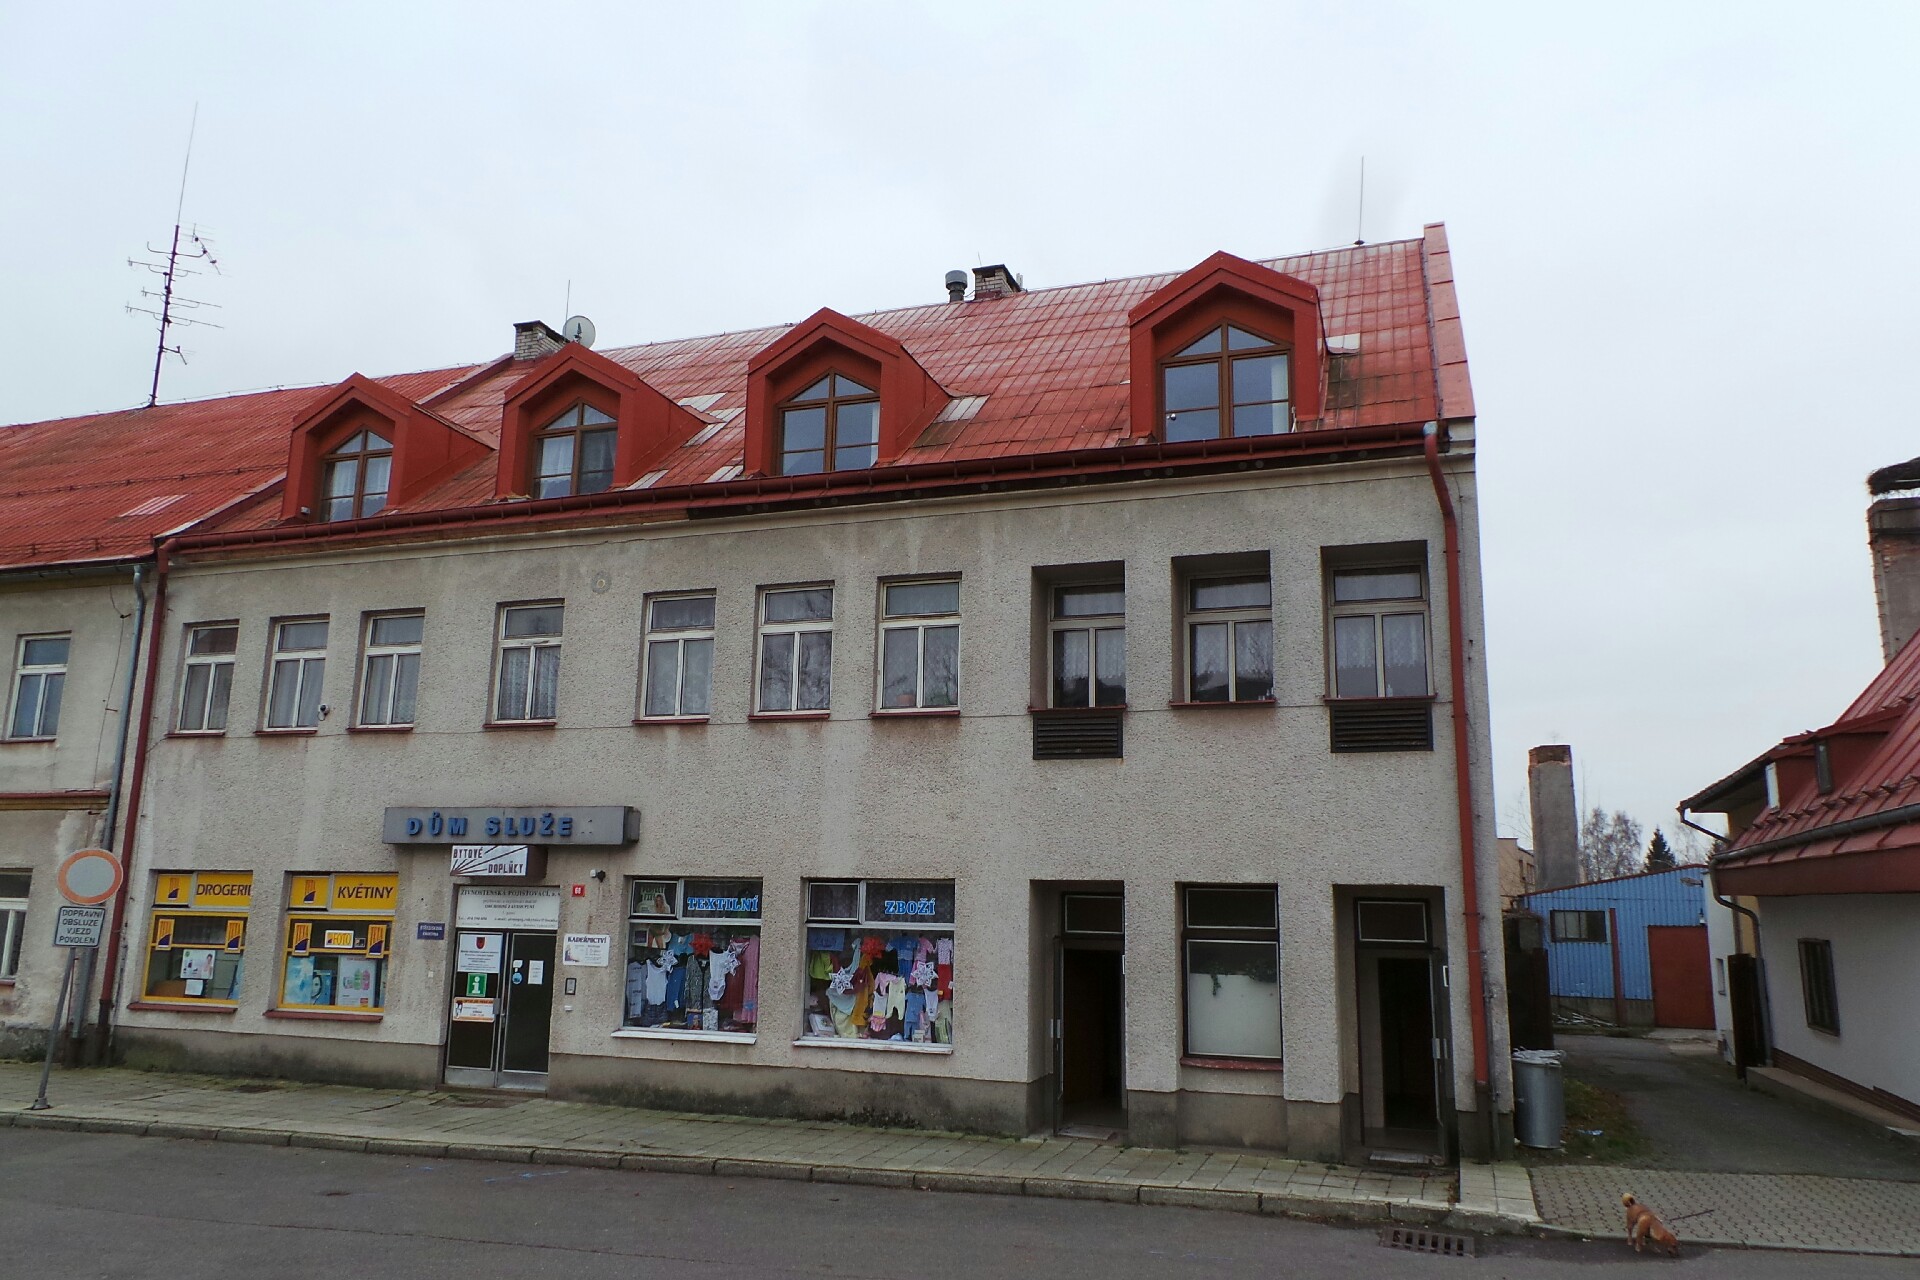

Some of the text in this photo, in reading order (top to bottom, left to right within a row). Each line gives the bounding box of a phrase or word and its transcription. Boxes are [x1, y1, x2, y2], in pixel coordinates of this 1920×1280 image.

[406, 811, 573, 837] DŮM SLUŽE
[453, 847, 483, 859] BYTOVÉ
[488, 860, 524, 874] DOPLŇKY
[687, 895, 759, 912] TEXTILNÍ
[884, 897, 936, 915] ZBOŽÍ
[67, 927, 92, 935] VJEZD
[59, 935, 96, 944] POVOLEN
